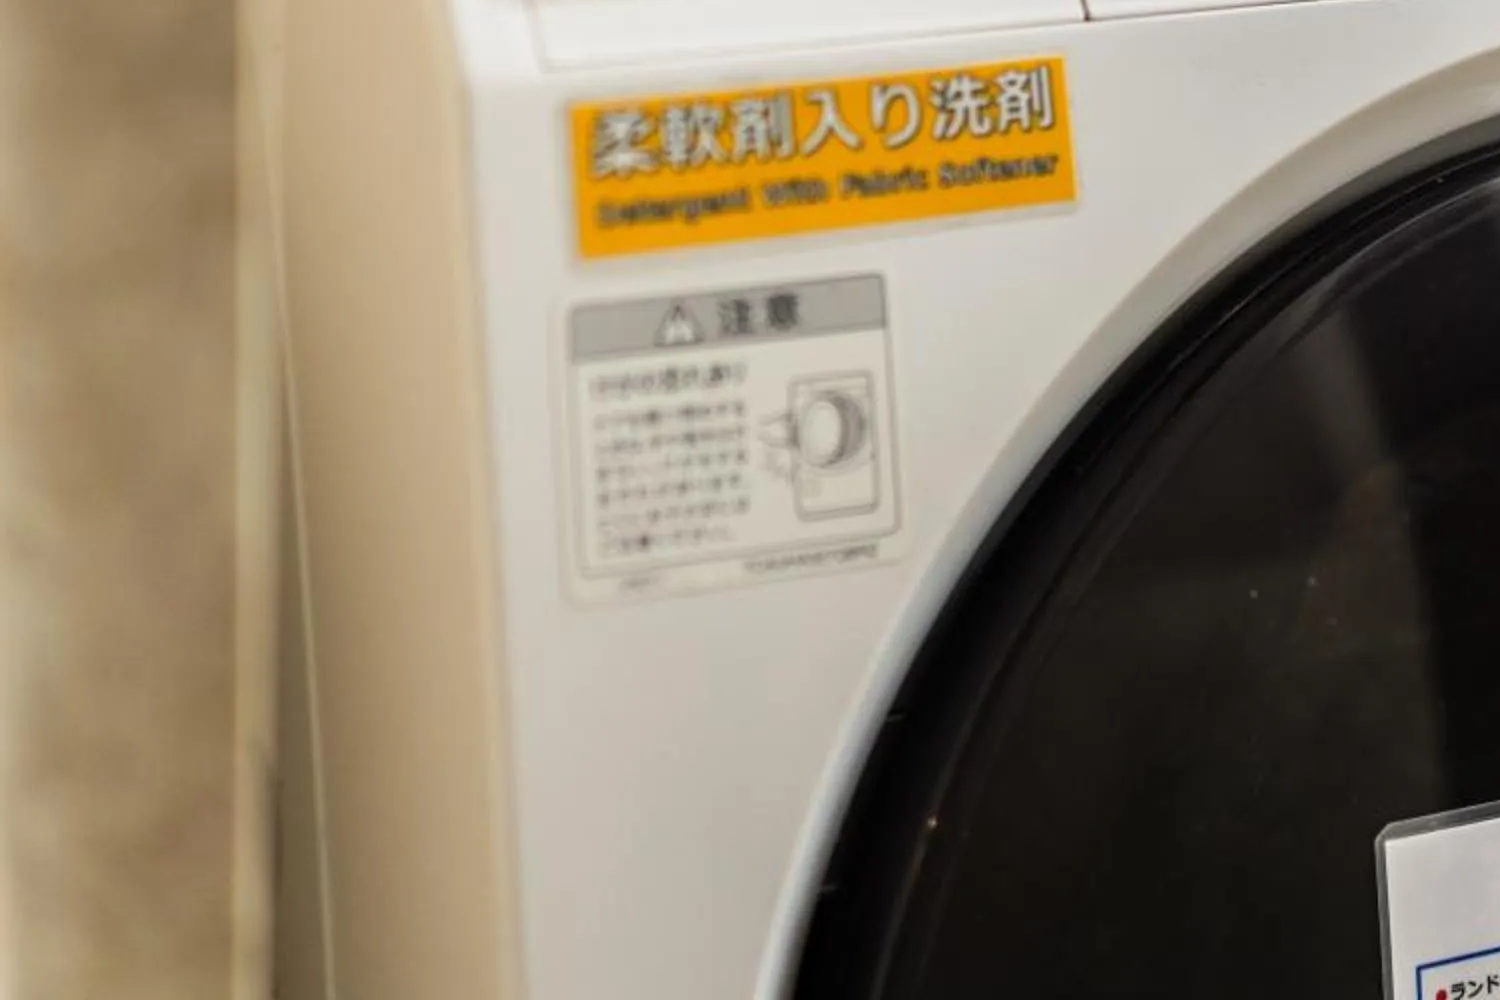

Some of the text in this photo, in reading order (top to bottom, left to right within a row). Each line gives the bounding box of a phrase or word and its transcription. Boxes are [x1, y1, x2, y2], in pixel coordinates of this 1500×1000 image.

[590, 64, 1055, 179] 柔軟剤入り洗剤
